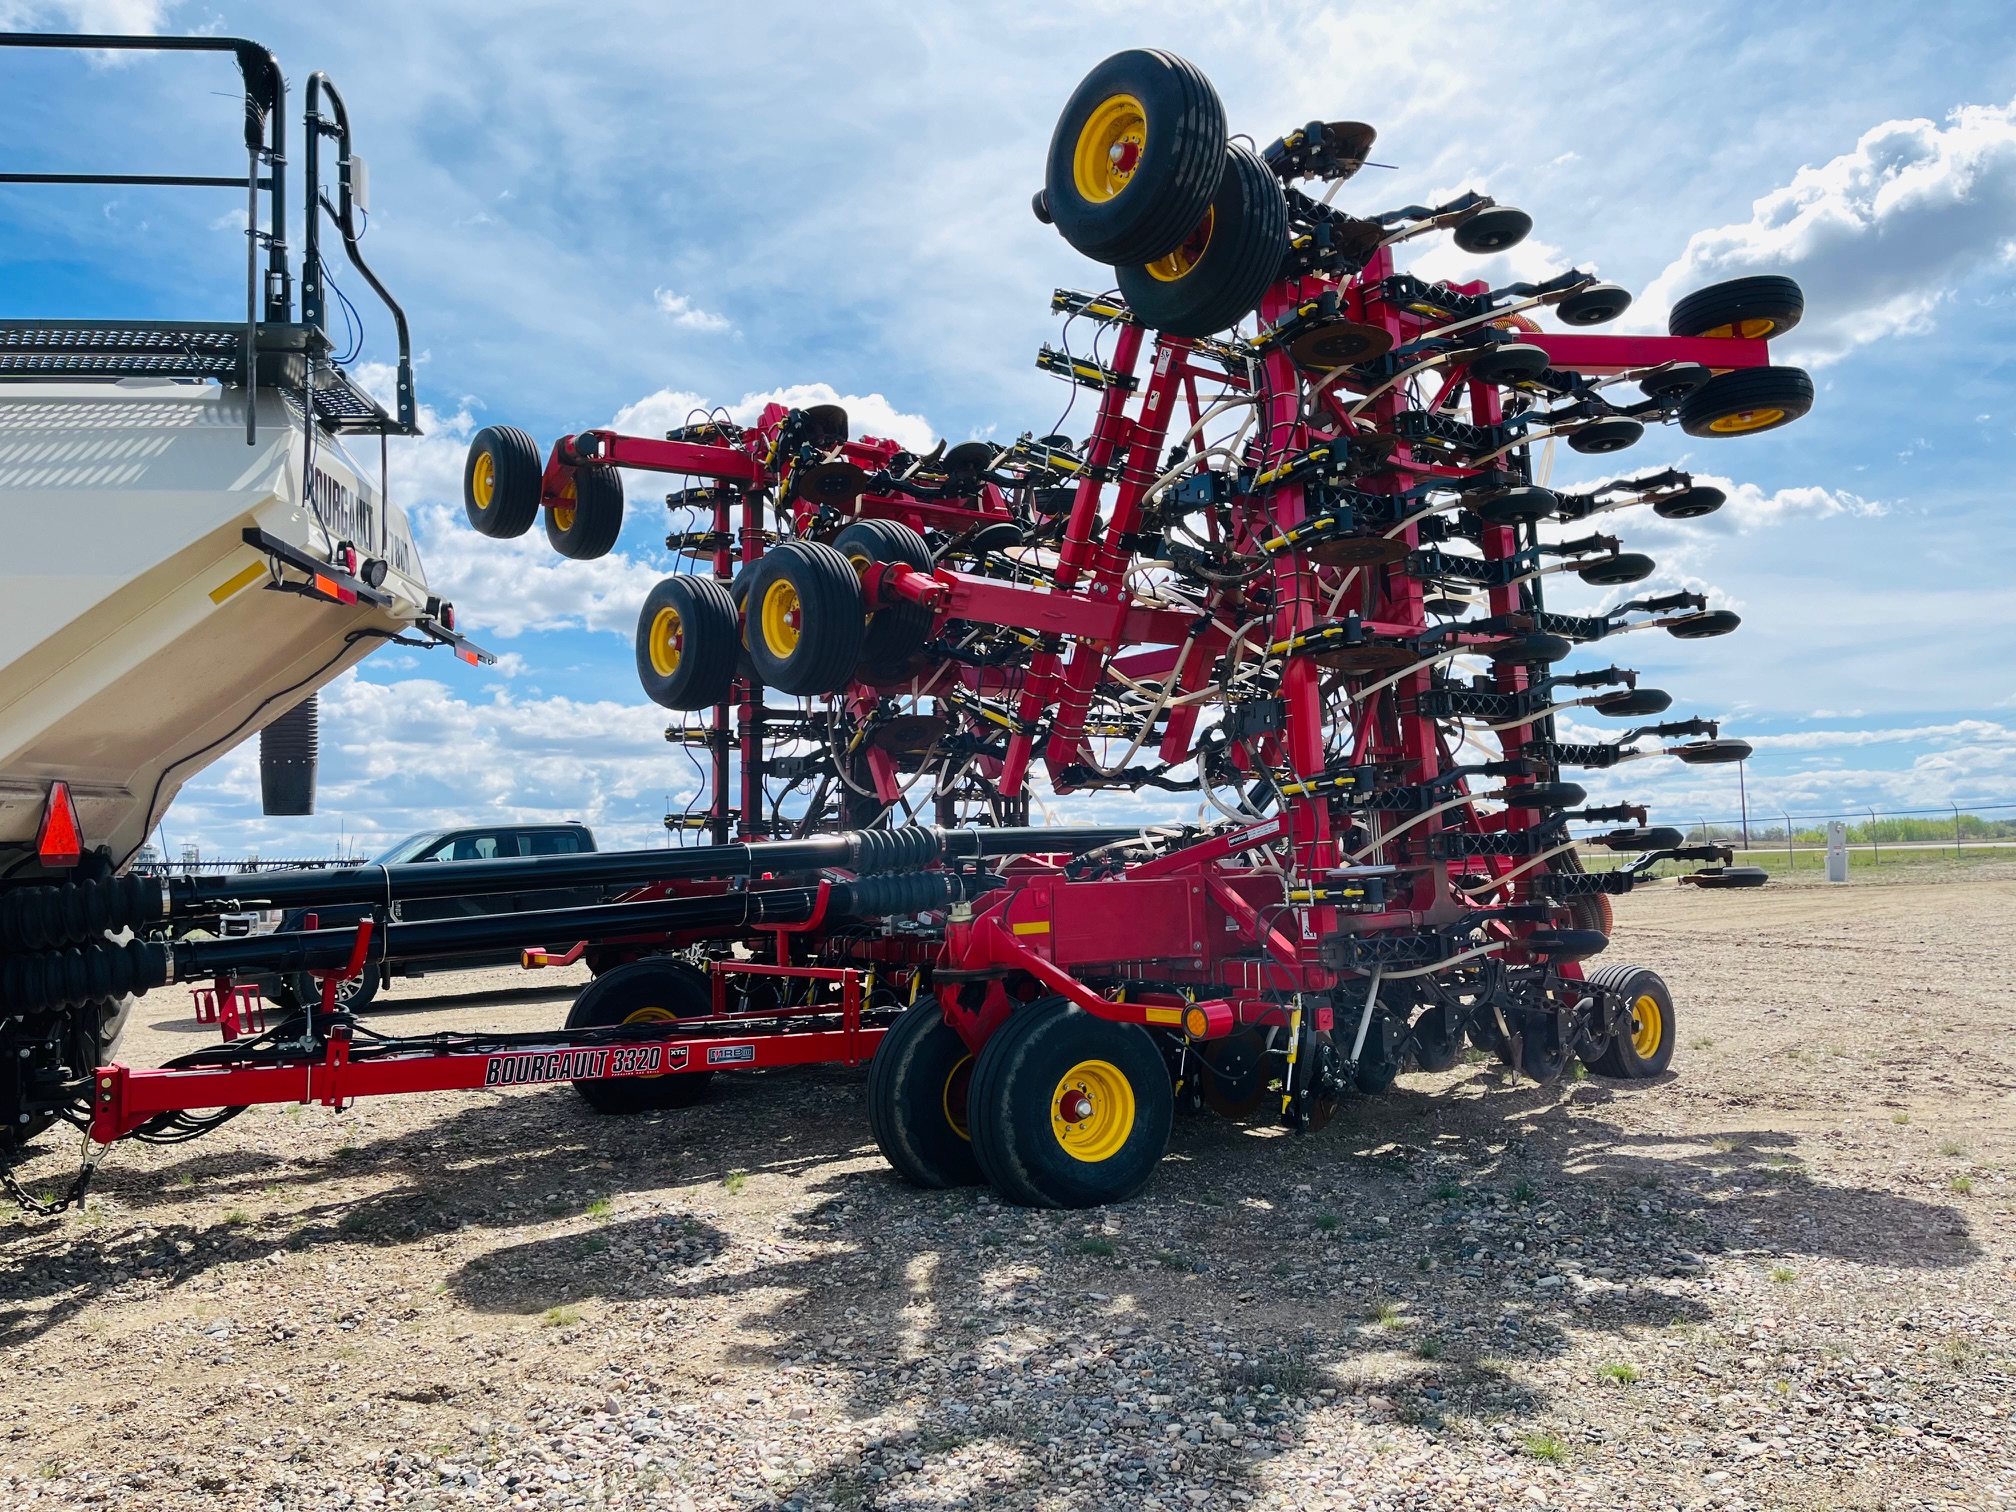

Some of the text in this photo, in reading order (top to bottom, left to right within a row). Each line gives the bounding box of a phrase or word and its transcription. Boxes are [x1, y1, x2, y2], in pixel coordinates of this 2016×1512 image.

[313, 466, 373, 552] OURGAULT
[485, 1046, 662, 1086] BOURGAULT 3320
